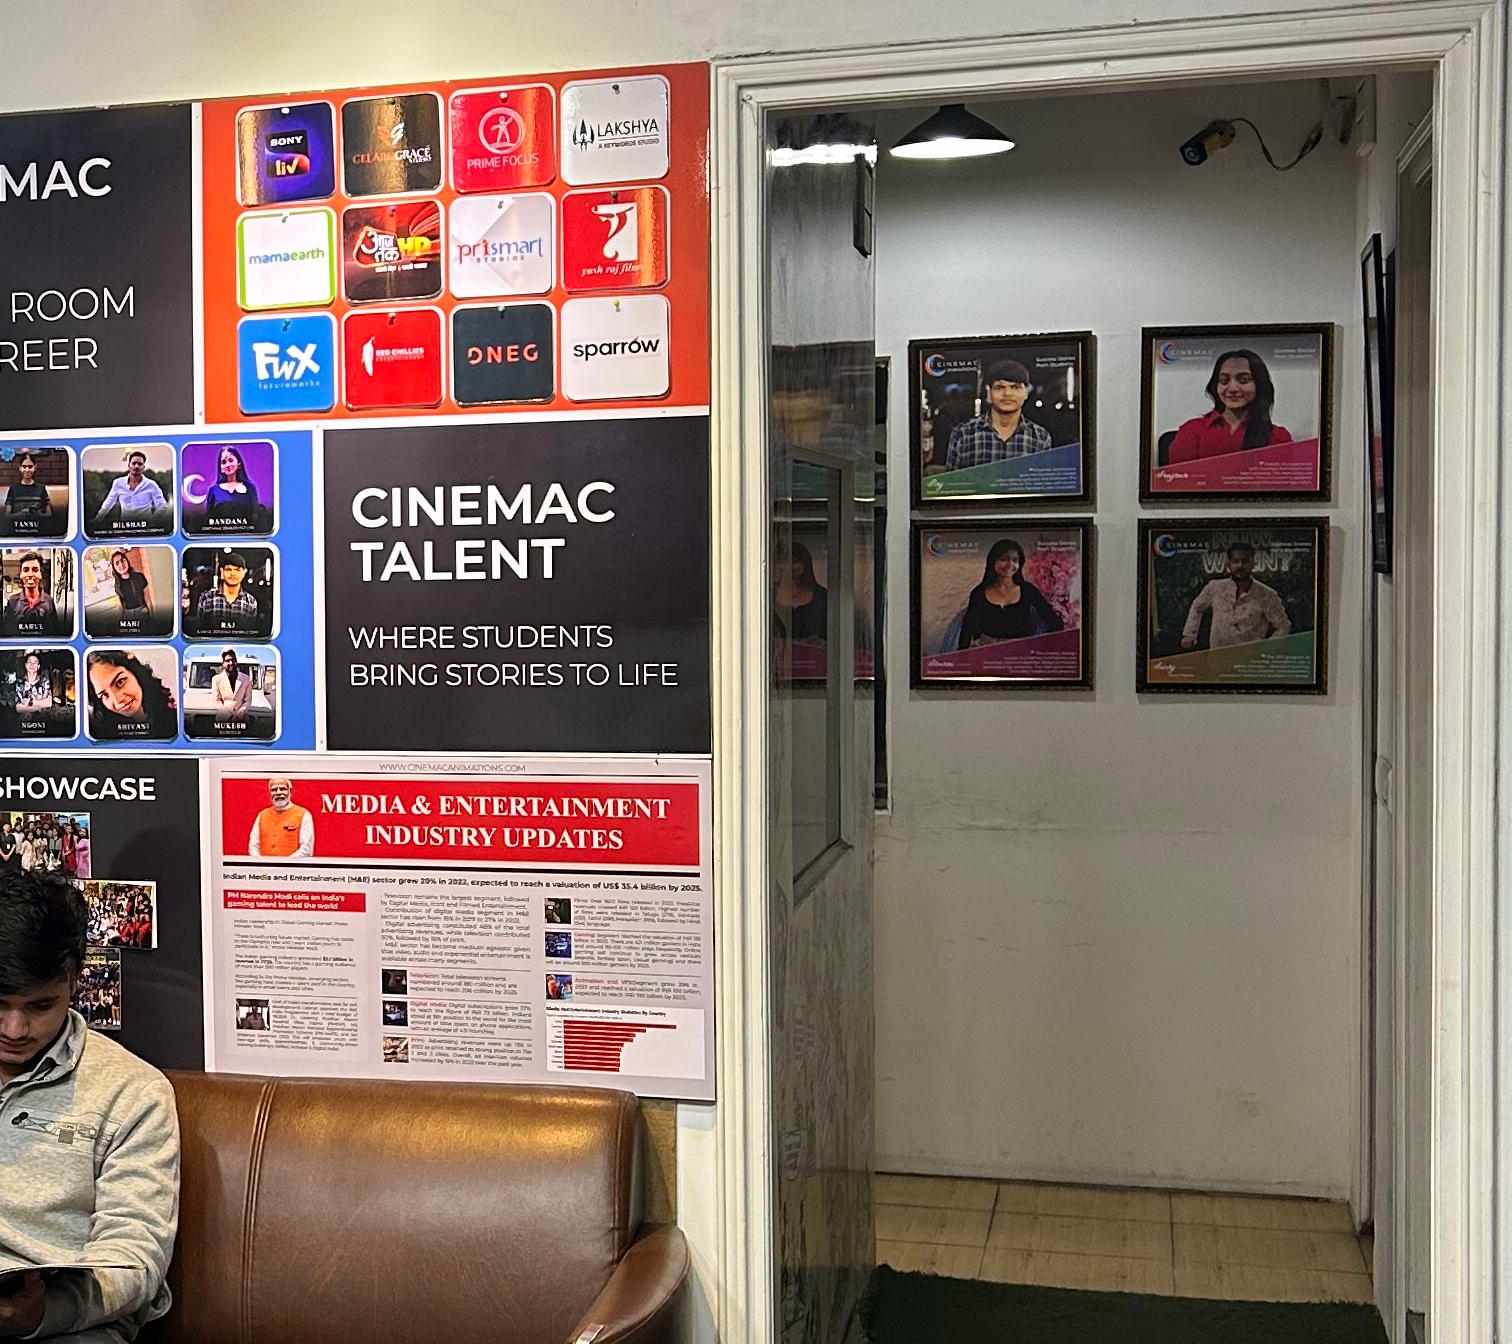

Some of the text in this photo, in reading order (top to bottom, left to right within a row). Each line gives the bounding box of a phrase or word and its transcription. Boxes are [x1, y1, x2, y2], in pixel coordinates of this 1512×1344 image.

[597, 118, 659, 138] LAKSHYA
[270, 136, 303, 147] SONY
[467, 153, 539, 170] PRIME FOCUS
[249, 247, 325, 265] mamaearth
[397, 237, 431, 255] HD
[457, 238, 544, 265] prismart
[11, 286, 135, 323] ROOM
[467, 343, 539, 365] DNEG
[351, 481, 616, 528] CINEMAC
[112, 521, 147, 529] DILSHAD
[208, 518, 248, 526] BANDANA
[350, 538, 566, 582] TALENT
[348, 625, 613, 649] WHERE STUDENTS
[350, 663, 679, 687] BRING STORIES TO LIFE
[379, 762, 526, 773] WWW.CINEMACANIMATIONS.COM
[320, 793, 671, 820] MEDIA & ENTERTAINMENT
[365, 824, 624, 851] INDUSTRY UPDATES
[372, 876, 396, 884] sector
[398, 878, 418, 886] grew
[471, 879, 508, 888] expected
[552, 881, 590, 889] valuation
[593, 881, 602, 889] of
[668, 884, 679, 892] by
